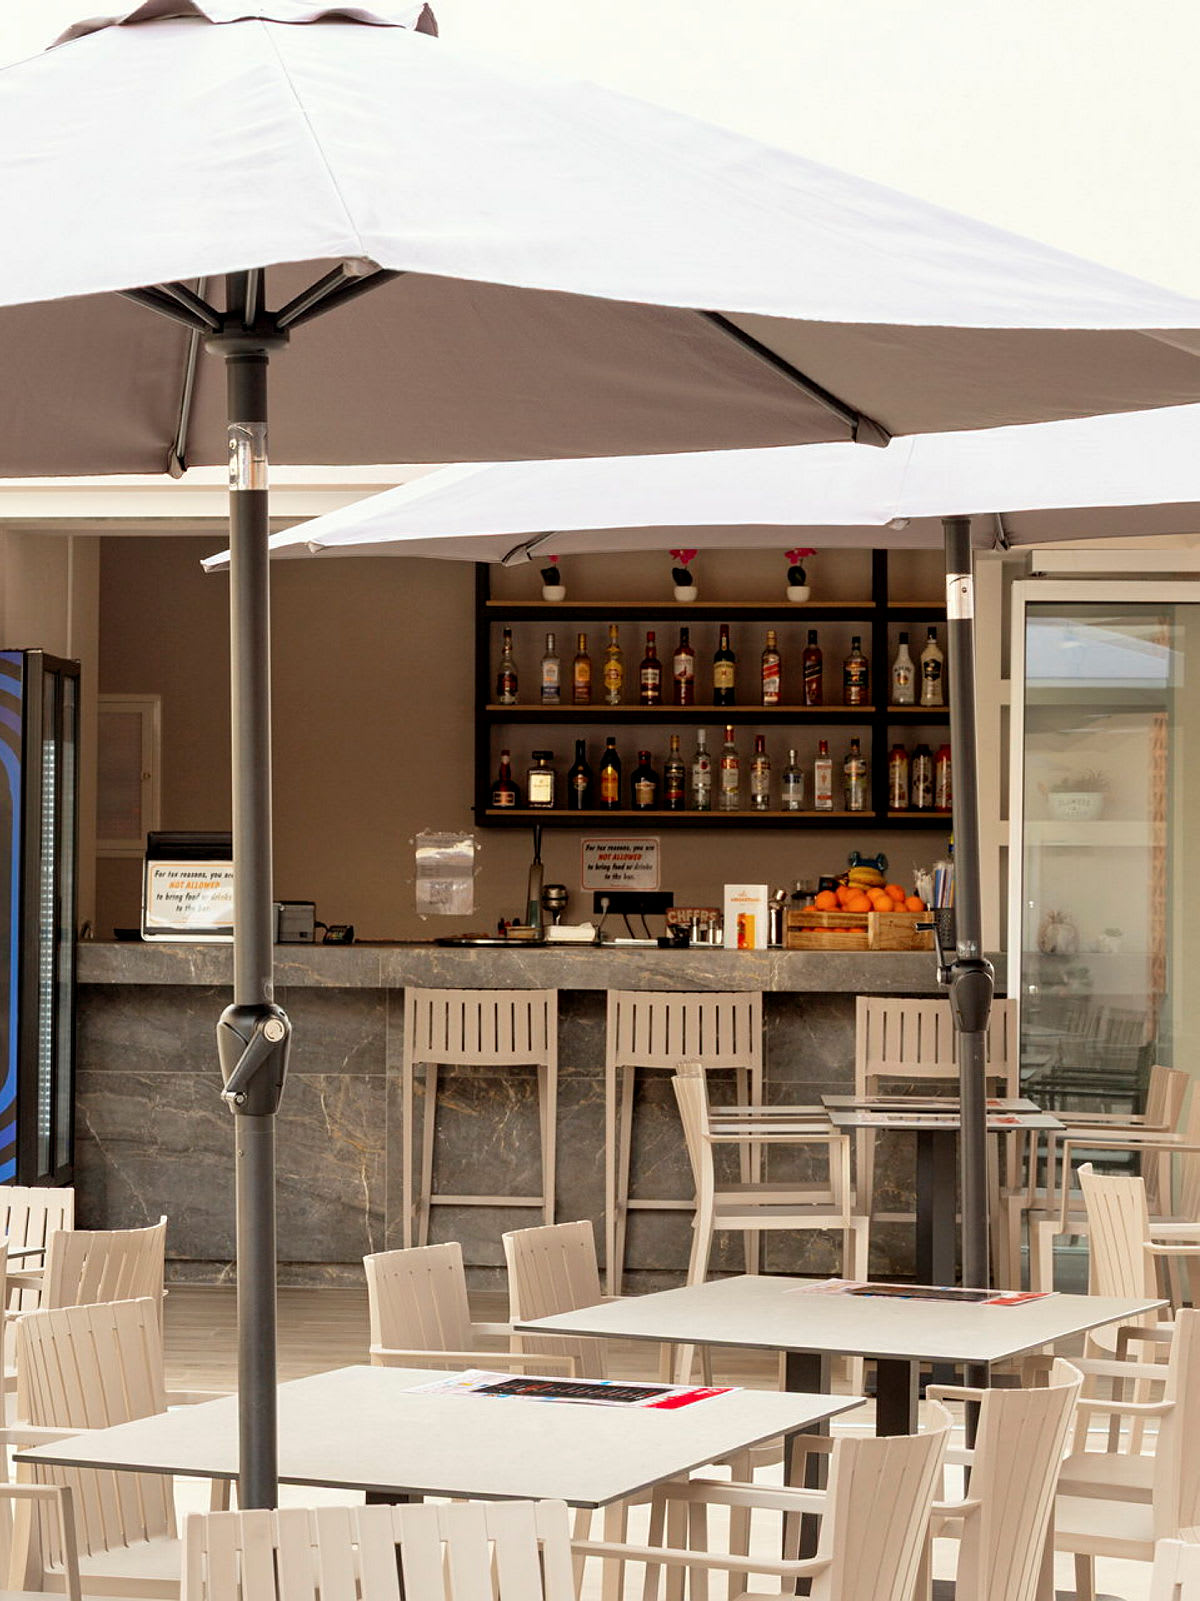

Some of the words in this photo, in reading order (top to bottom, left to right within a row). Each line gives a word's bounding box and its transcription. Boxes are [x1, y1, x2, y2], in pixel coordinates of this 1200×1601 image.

[154, 870, 166, 878] For
[210, 872, 222, 880] you
[168, 881, 184, 889] NOT
[165, 893, 183, 902] bring
